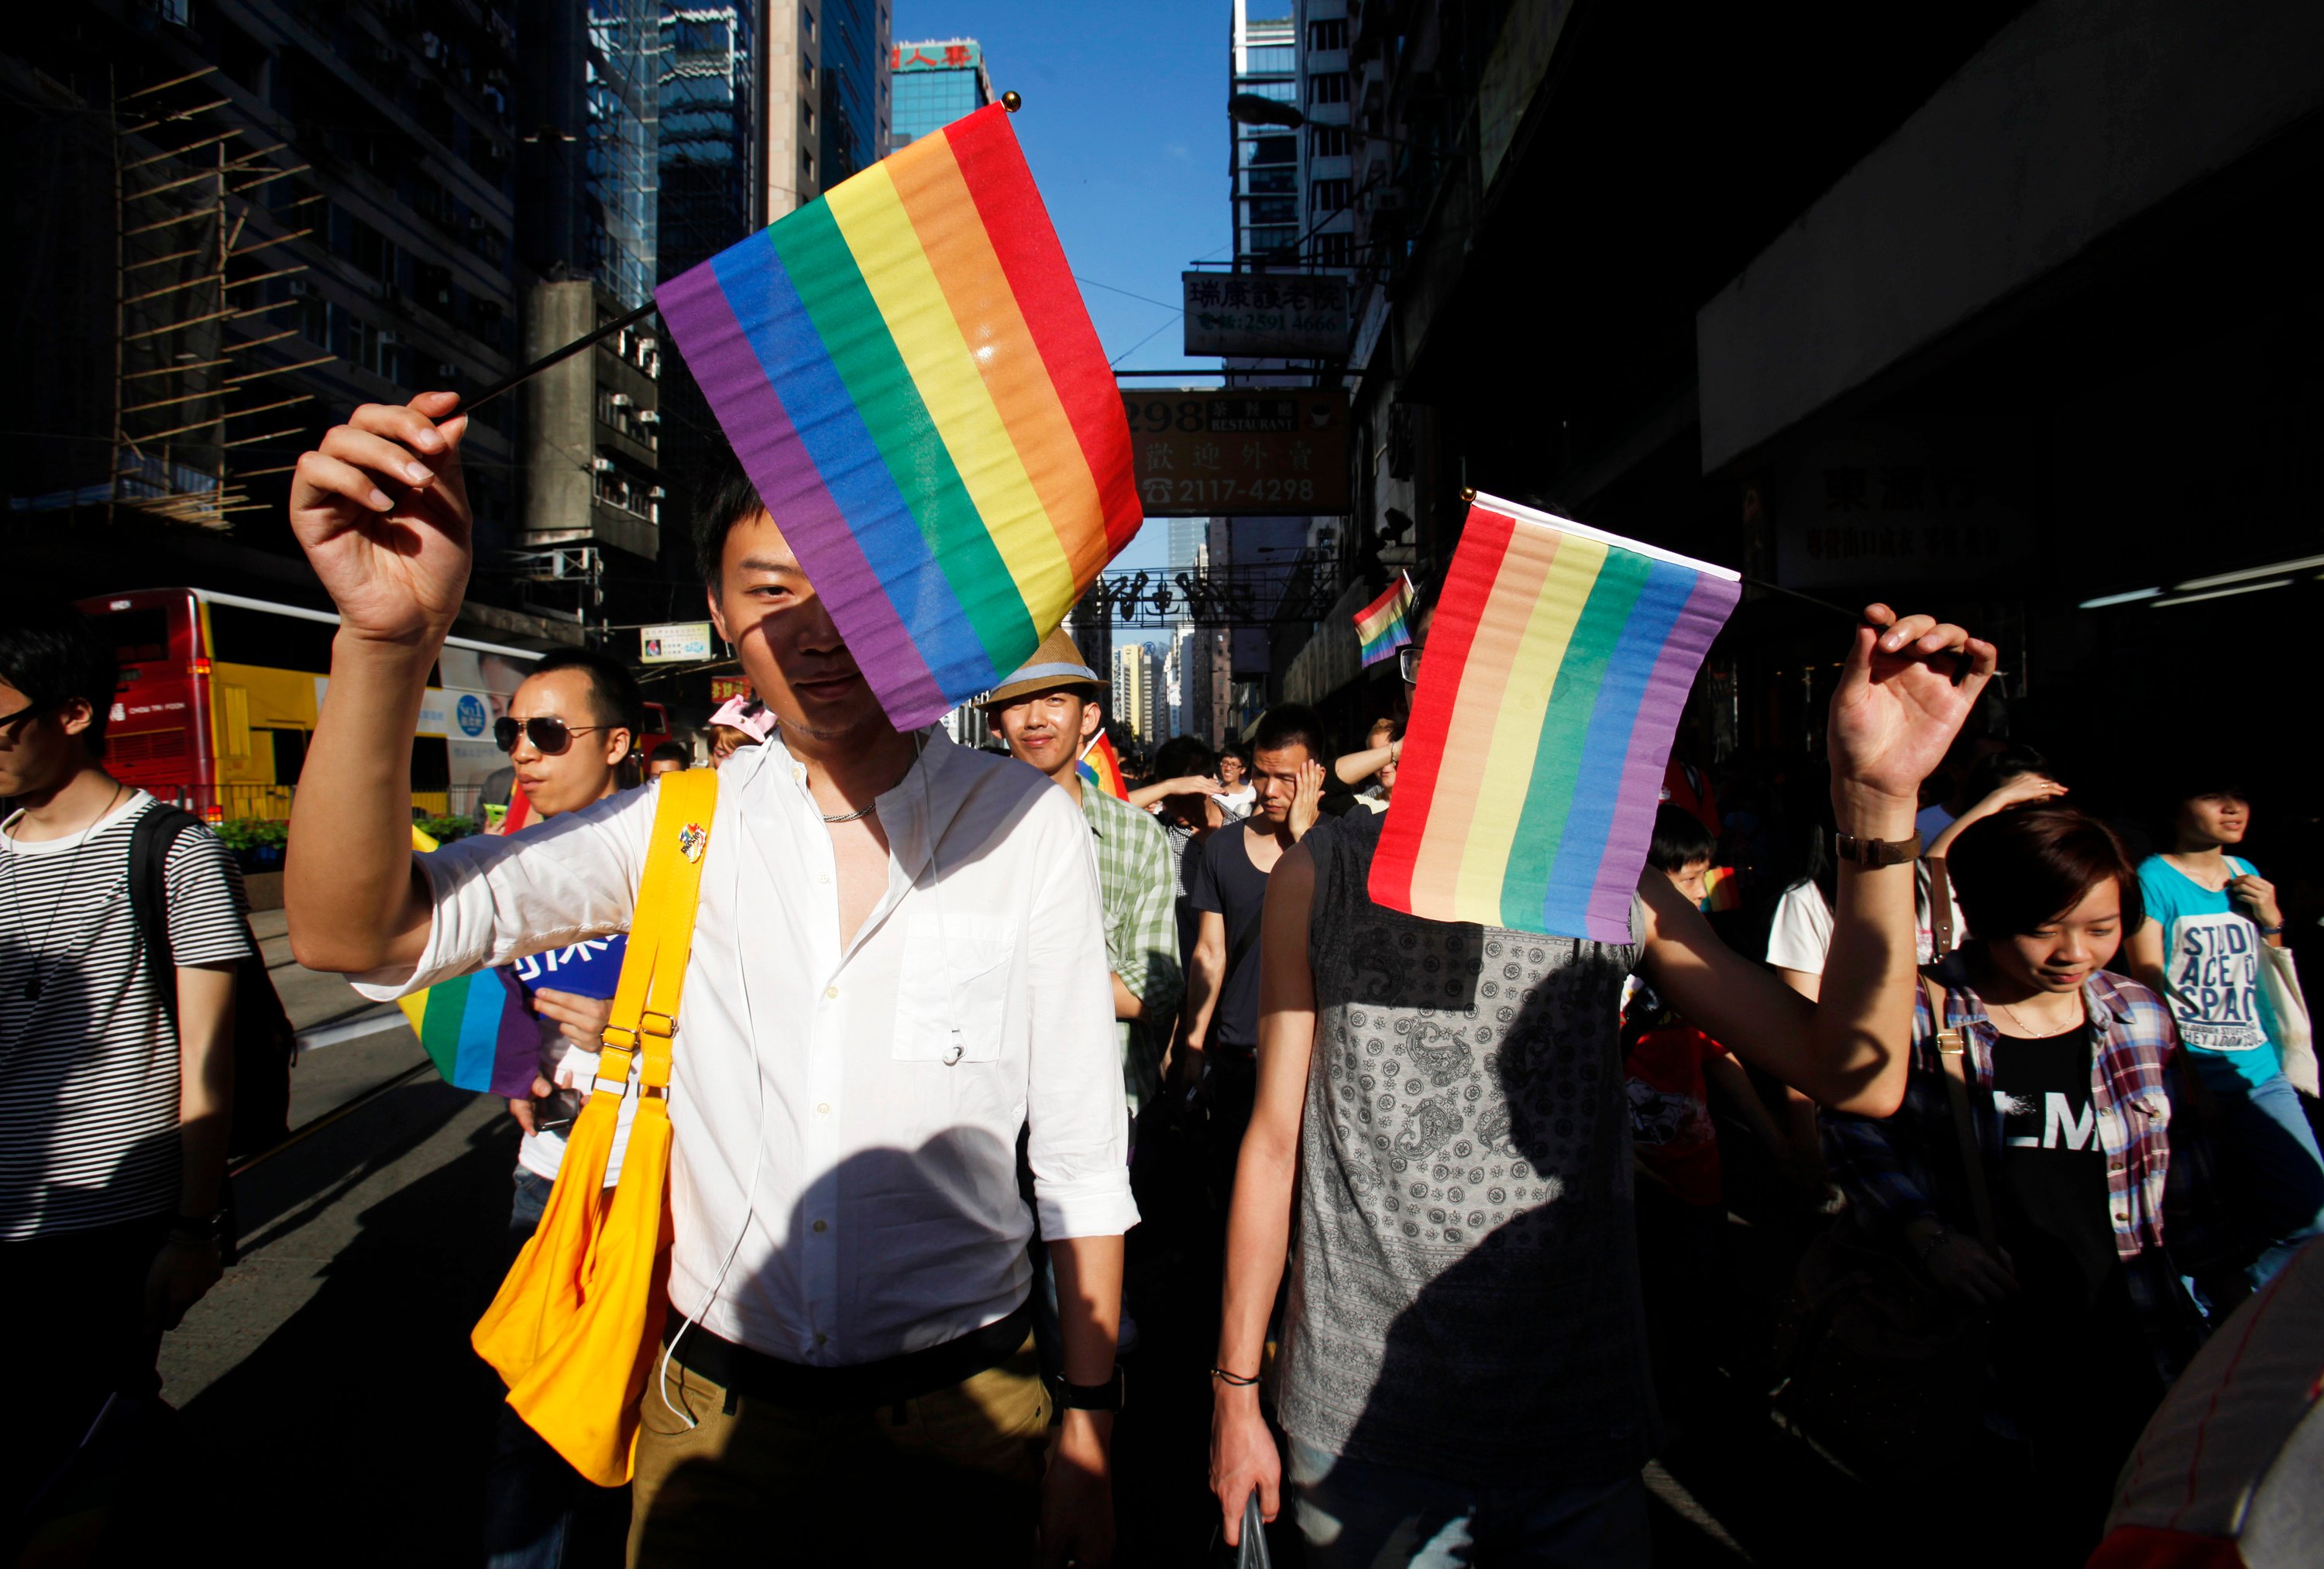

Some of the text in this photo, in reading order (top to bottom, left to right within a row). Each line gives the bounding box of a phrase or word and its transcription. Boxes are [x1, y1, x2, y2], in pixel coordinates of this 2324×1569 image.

[1190, 279, 1344, 311] 瑞康護老院
[1292, 314, 1337, 331] 4666
[1212, 417, 1293, 431] RESTAURANT
[1146, 440, 1312, 472] 歡迎外賣
[1178, 478, 1315, 502] 2117-4298
[2178, 955, 2234, 987] ACE
